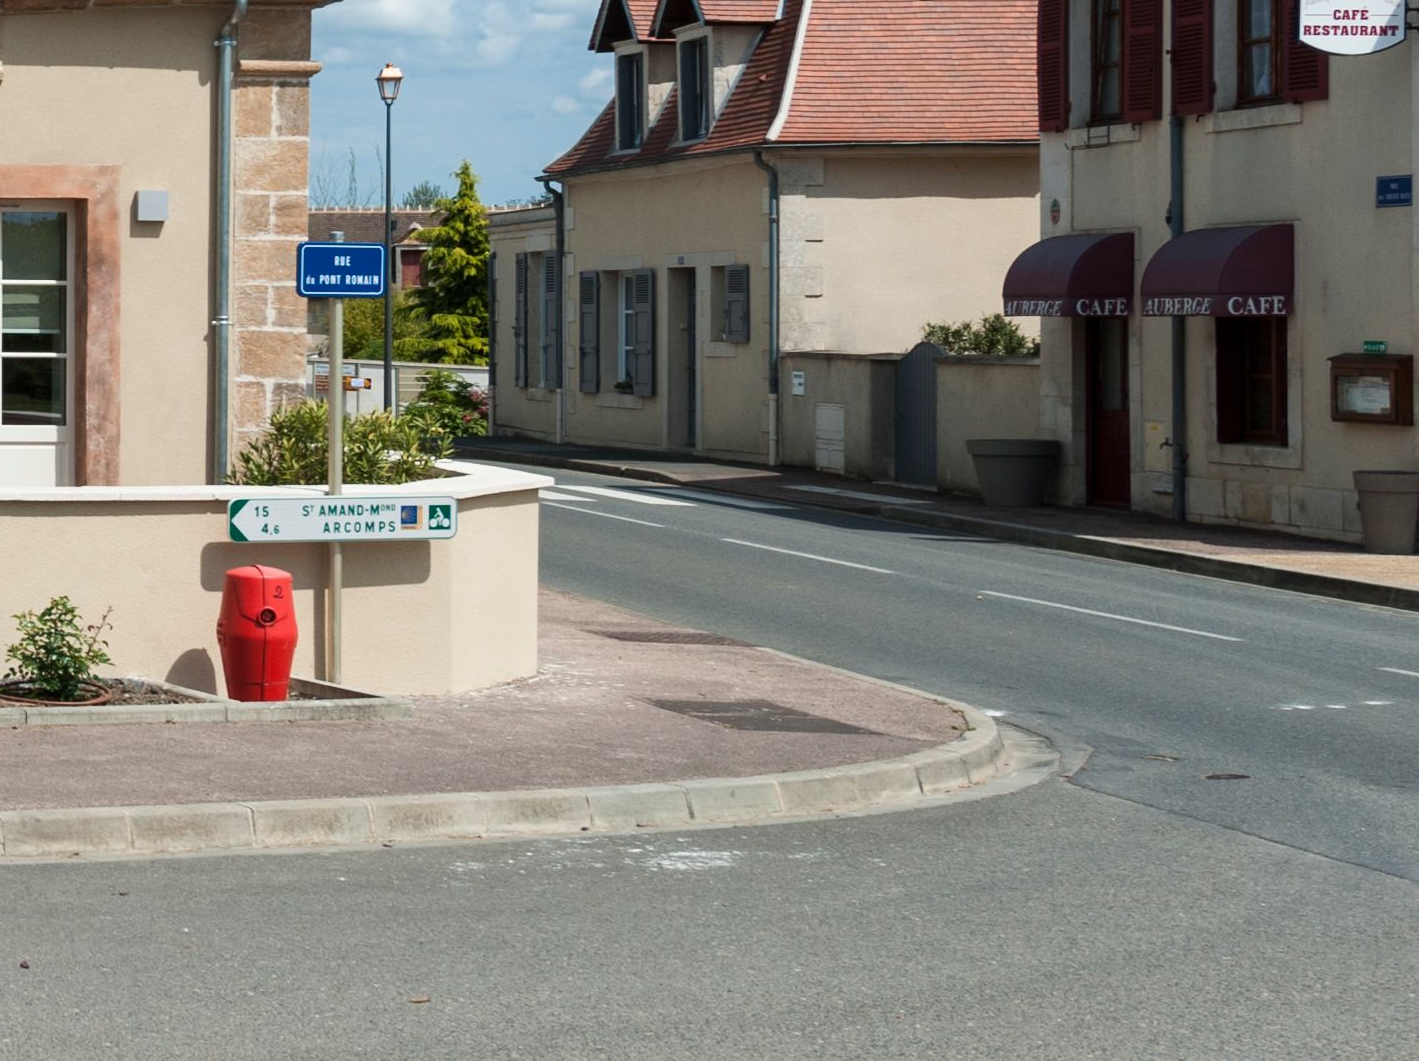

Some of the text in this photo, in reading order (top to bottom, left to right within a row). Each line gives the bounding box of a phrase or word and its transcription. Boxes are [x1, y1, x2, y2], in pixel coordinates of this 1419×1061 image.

[1333, 6, 1369, 20] CAFÉ
[1303, 25, 1399, 37] RESTAURANT
[334, 255, 351, 266] RUE
[319, 274, 341, 285] PONT
[345, 274, 379, 285] ROMAIN
[1005, 300, 1062, 315] AUBERGE
[1144, 297, 1212, 315] AUBERGE
[254, 506, 270, 517] 15
[261, 521, 397, 536] 4,6 ARCOMPS
[273, 585, 284, 599] 2
